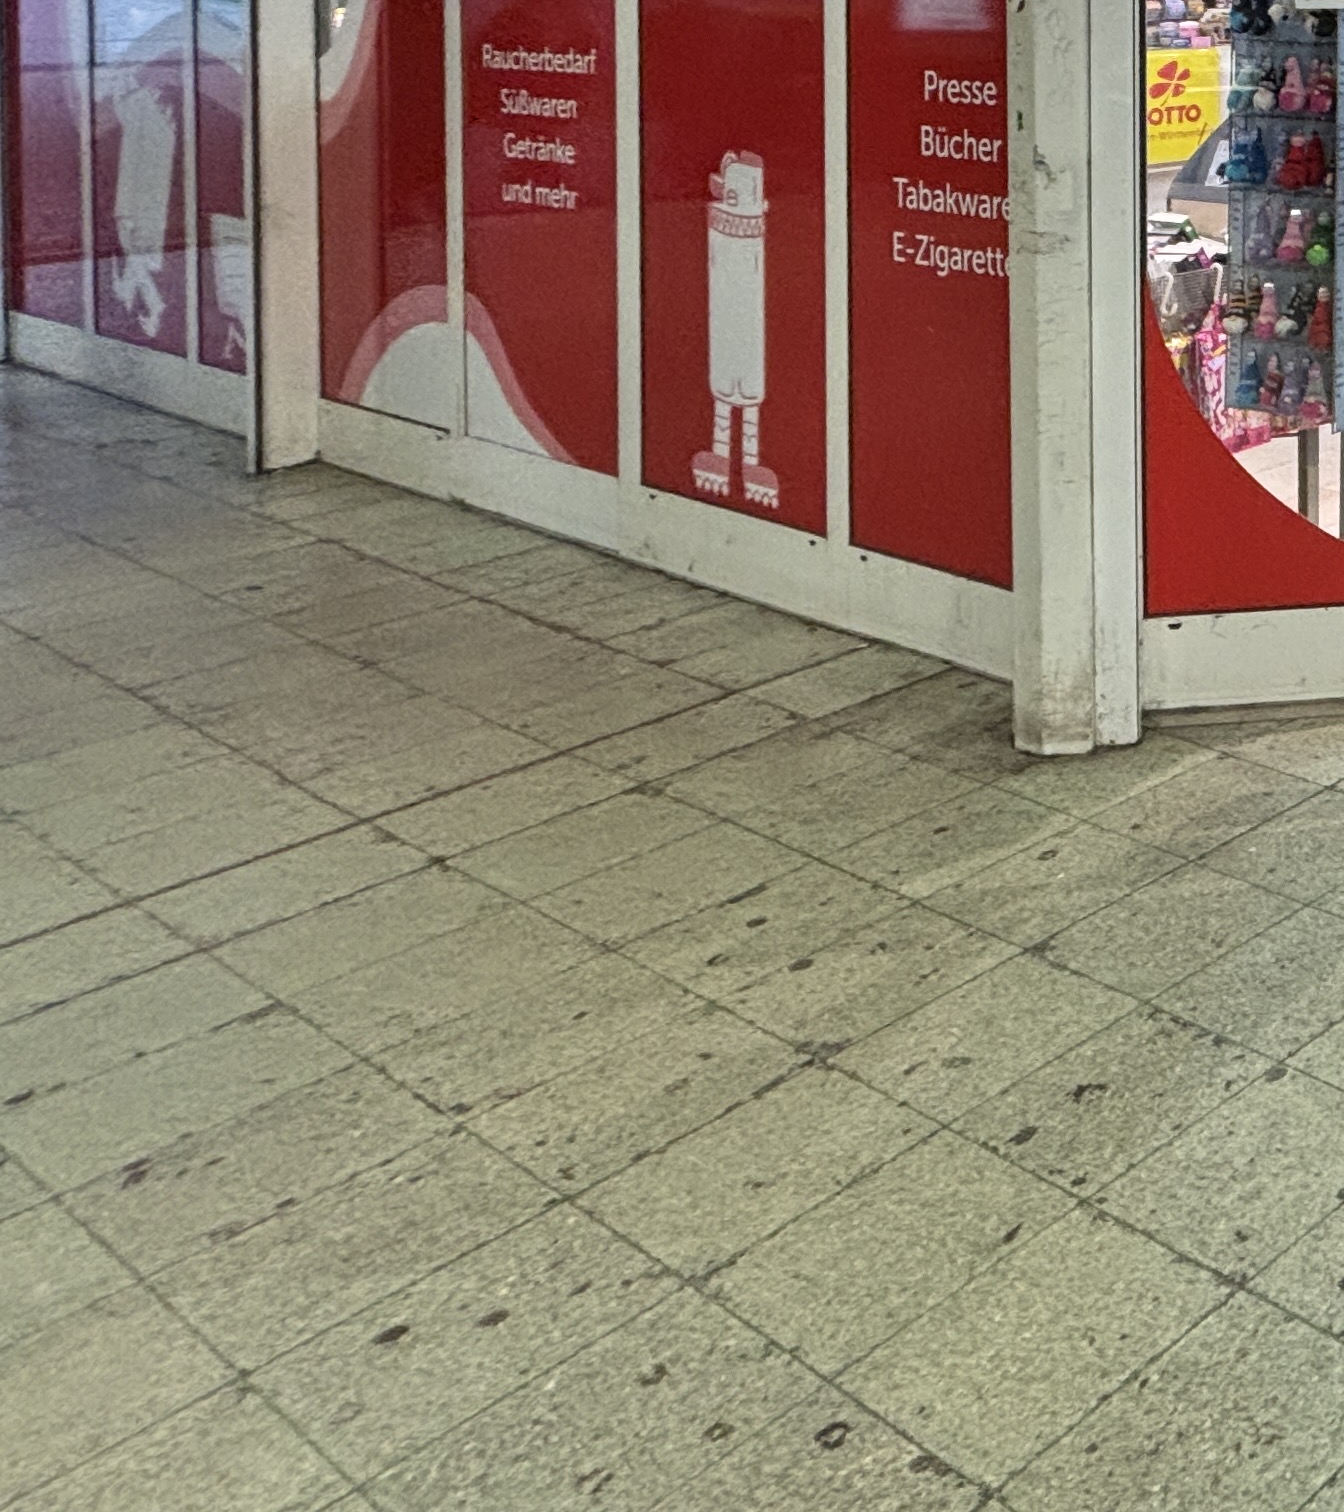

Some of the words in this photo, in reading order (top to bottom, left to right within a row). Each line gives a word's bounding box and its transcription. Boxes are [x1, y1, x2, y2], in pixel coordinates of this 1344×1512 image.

[482, 43, 597, 75] Raucherbedarf
[500, 88, 578, 119] Süßwaren
[925, 70, 997, 106] Presse
[1148, 104, 1202, 126] OTTO
[503, 133, 576, 165] Getränke
[921, 125, 1001, 163] Bücher
[502, 180, 531, 204] und
[535, 183, 578, 210] mehr
